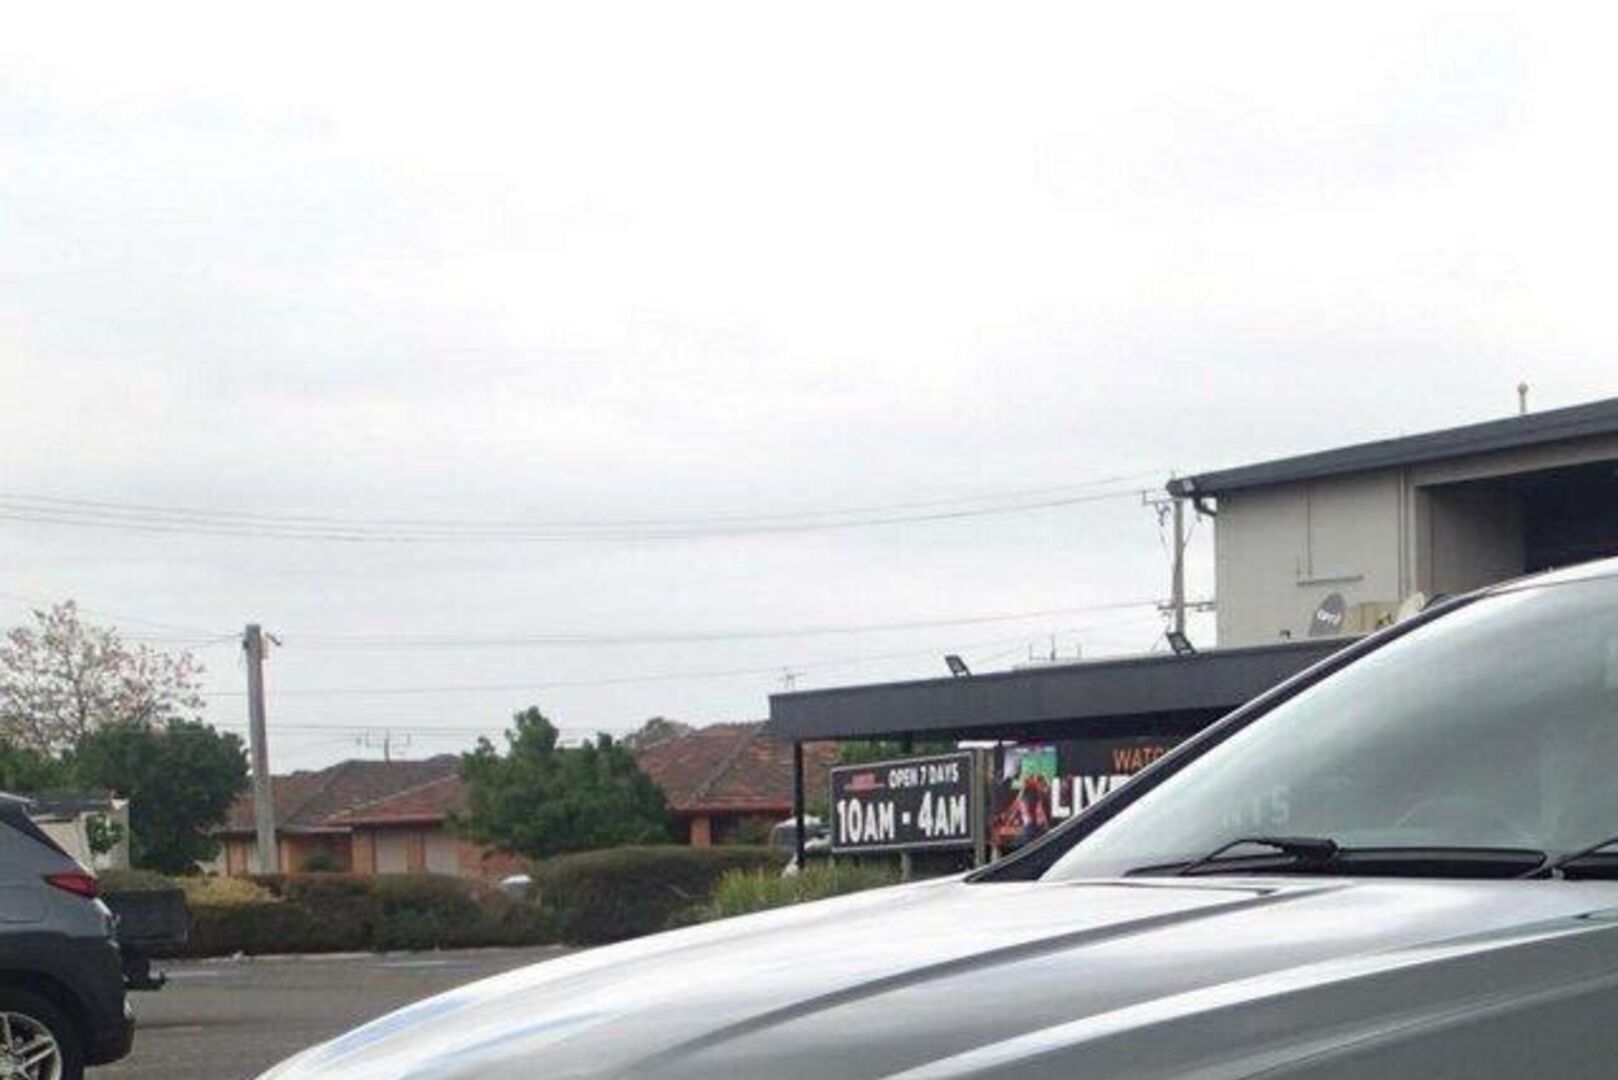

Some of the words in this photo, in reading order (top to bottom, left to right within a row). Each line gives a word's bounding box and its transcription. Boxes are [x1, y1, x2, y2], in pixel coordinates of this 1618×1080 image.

[888, 767, 918, 788] OPEN
[920, 765, 927, 786] 7
[928, 762, 959, 785] DAYS
[1053, 773, 1133, 818] LIV
[837, 798, 895, 843] 10AM
[918, 791, 967, 837] 4AM
